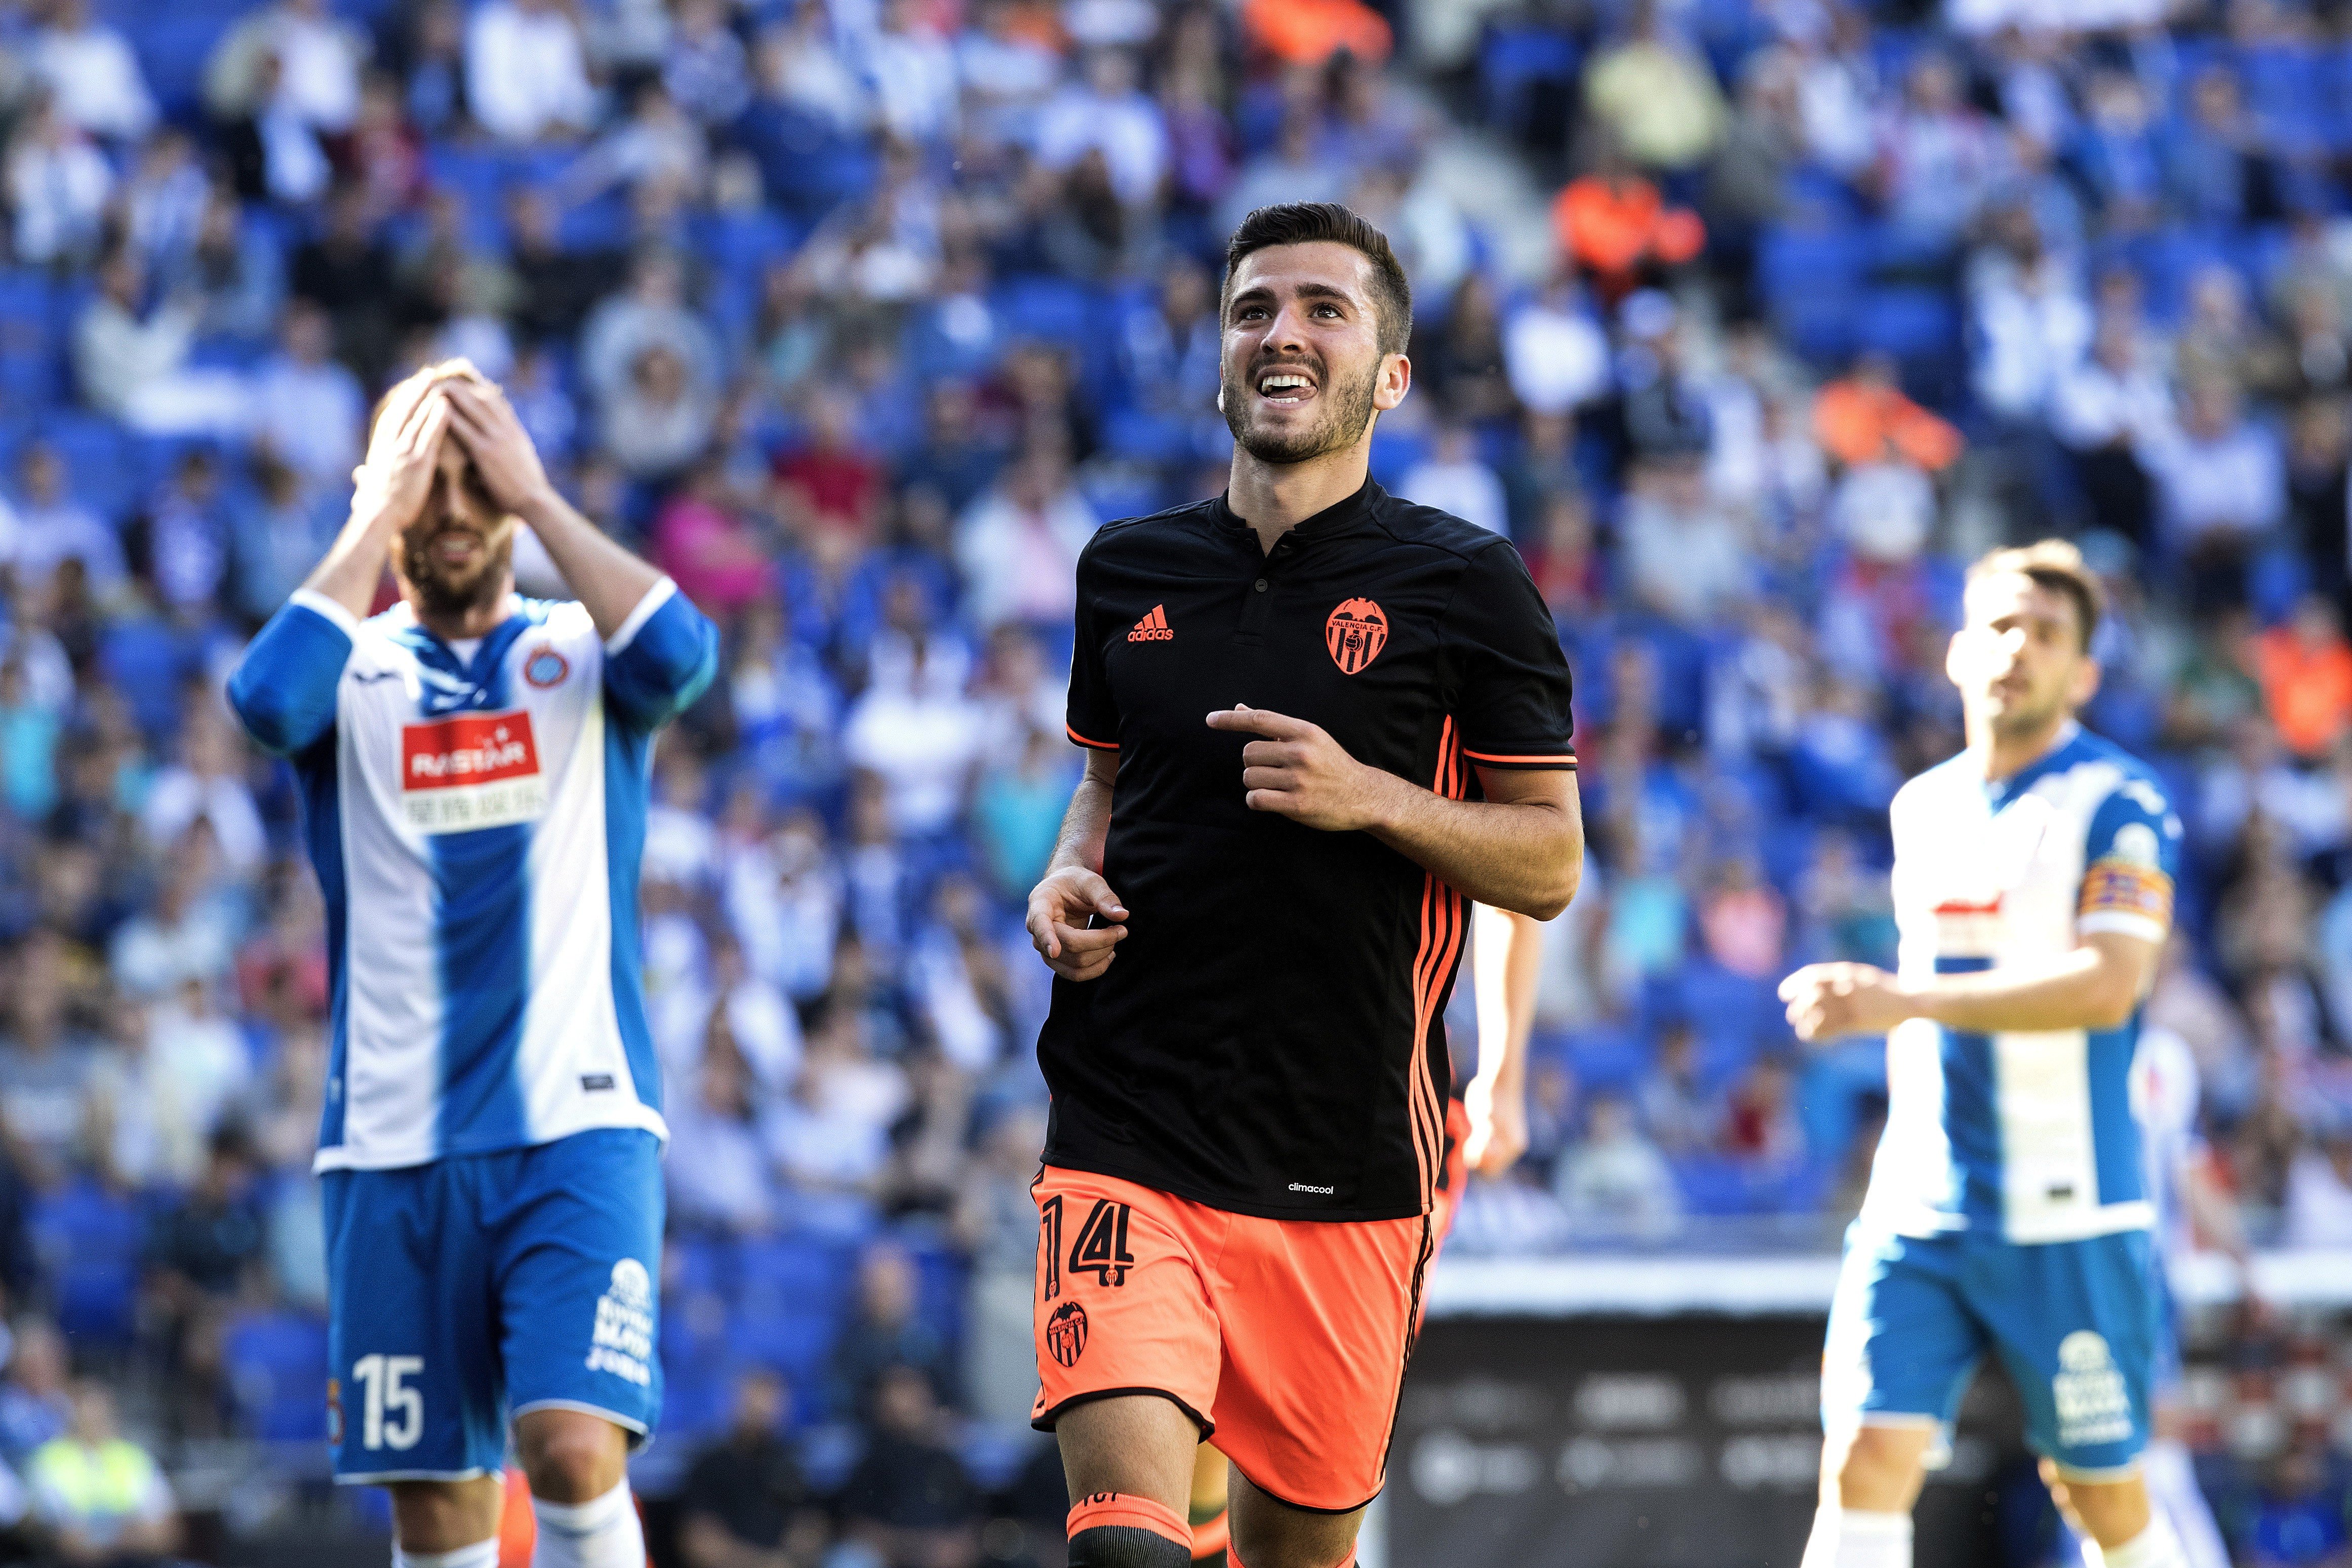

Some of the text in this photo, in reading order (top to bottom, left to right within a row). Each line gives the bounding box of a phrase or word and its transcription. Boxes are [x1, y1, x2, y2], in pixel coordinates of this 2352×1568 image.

[1332, 620, 1368, 630] VALENCIA
[1128, 628, 1174, 642] adidas
[1288, 1182, 1334, 1194] climacool
[1043, 1195, 1134, 1302] 14
[352, 1352, 425, 1451] 15
